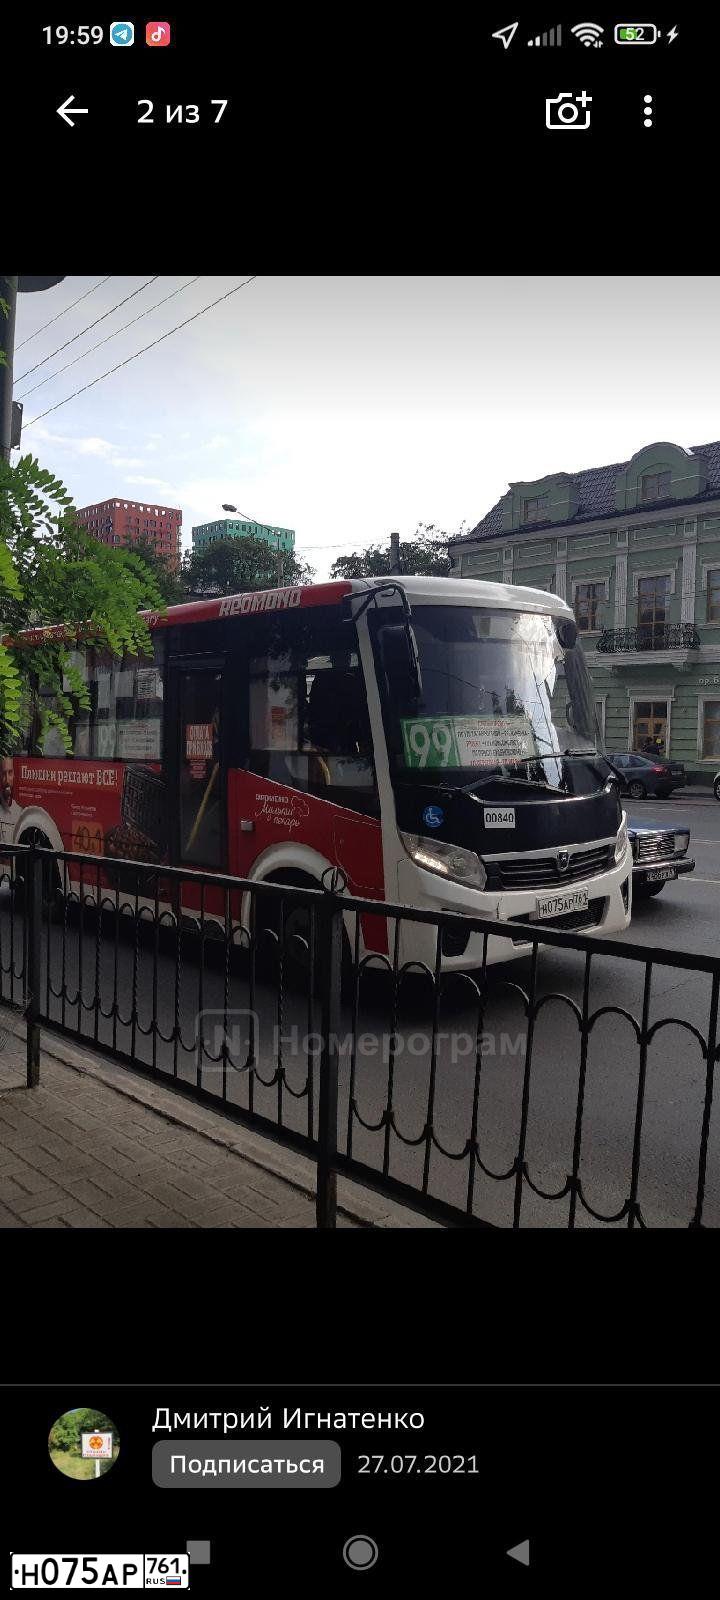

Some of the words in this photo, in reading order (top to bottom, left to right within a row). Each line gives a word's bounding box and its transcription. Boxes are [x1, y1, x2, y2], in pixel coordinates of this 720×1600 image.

[42, 26, 104, 46] 19:59
[625, 27, 645, 42] 52
[137, 100, 155, 124] 2
[165, 105, 201, 124] из
[211, 100, 228, 124] 7
[219, 589, 302, 616] REDMOND
[409, 723, 452, 767] 99
[58, 769, 95, 786] решают
[485, 812, 515, 824] 00840
[152, 1406, 272, 1433] Дмитрий
[283, 1407, 425, 1429] Игнатенко
[170, 1455, 325, 1476] Подписаться
[358, 1455, 480, 1474] 27.07.2021
